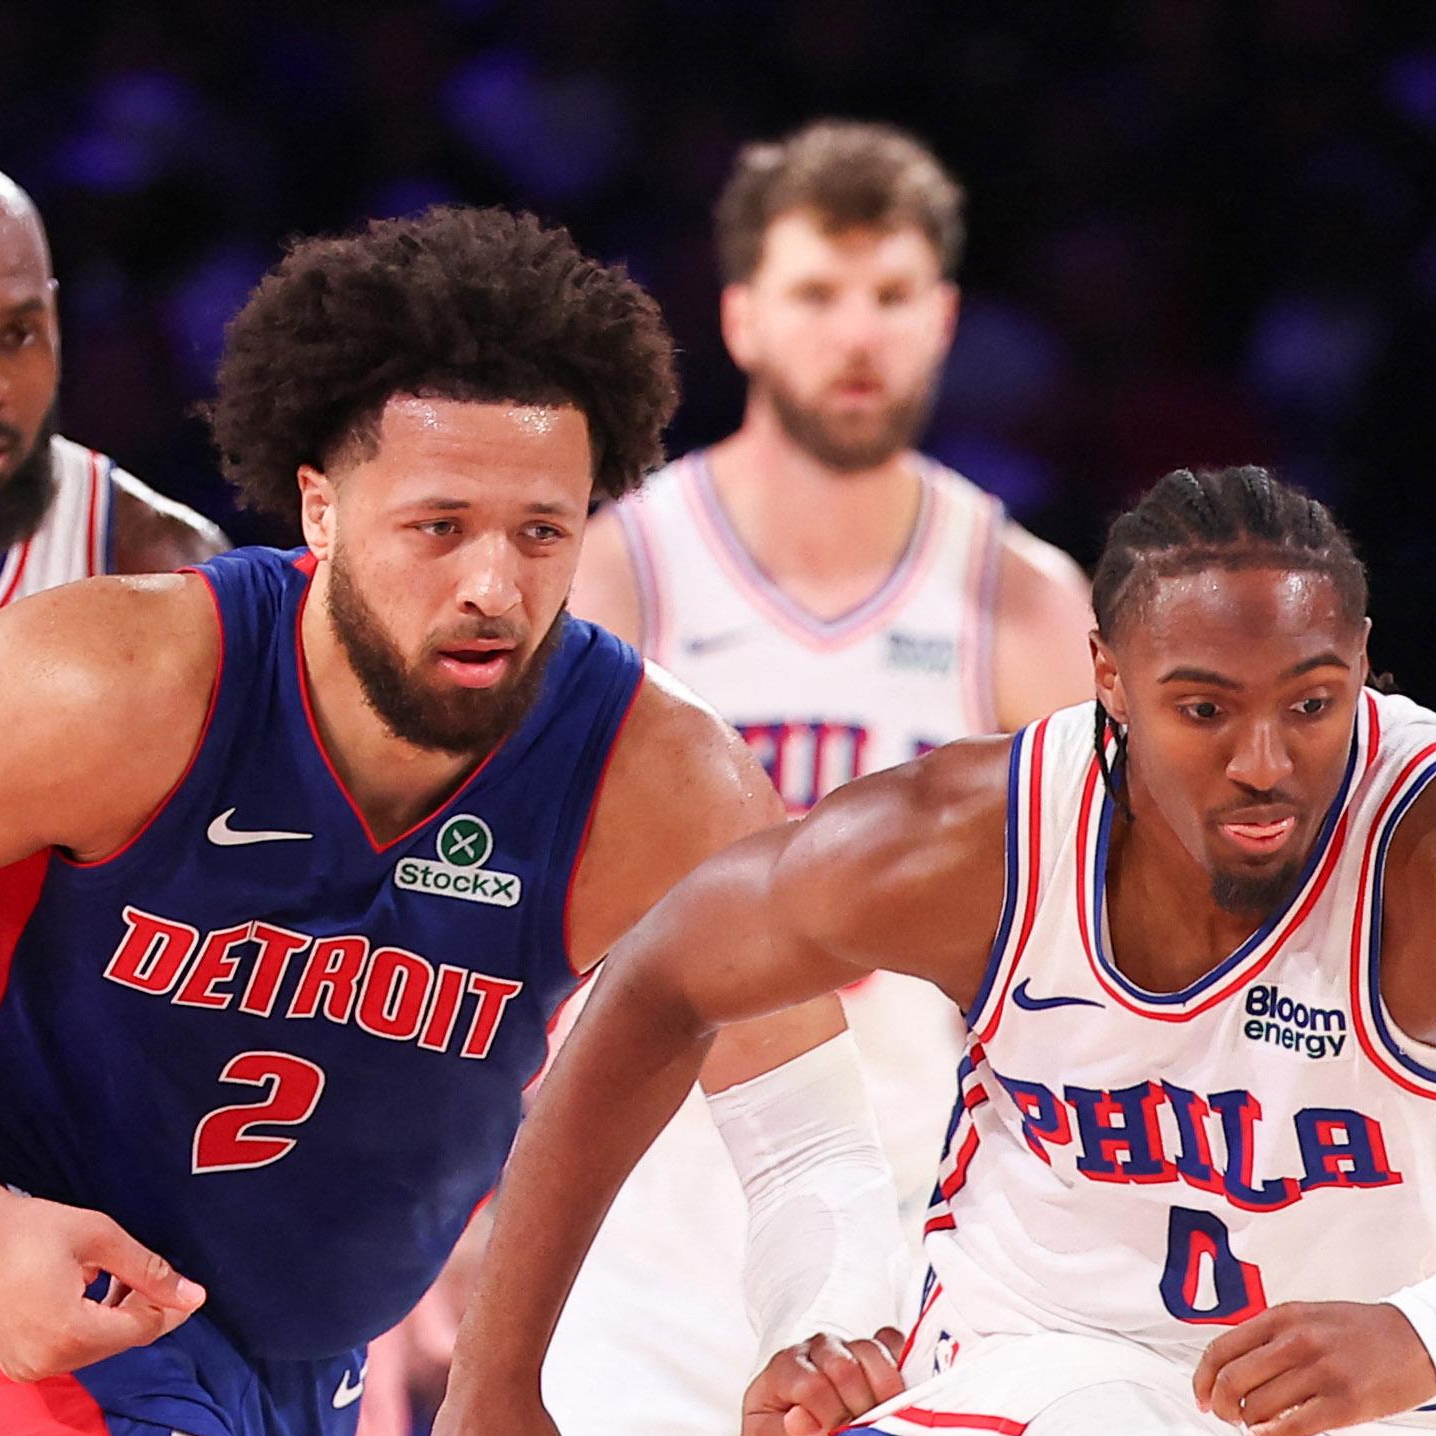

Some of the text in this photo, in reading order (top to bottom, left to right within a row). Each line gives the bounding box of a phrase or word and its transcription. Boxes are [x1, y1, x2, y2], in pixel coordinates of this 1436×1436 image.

[399, 863, 516, 901] StockX
[103, 905, 523, 1060] DETROIT
[1244, 1019, 1347, 1060] energy
[1245, 985, 1347, 1032] Bloom
[191, 1051, 326, 1175] 2
[993, 1071, 1404, 1213] PHILA
[1159, 1205, 1268, 1326] 0
